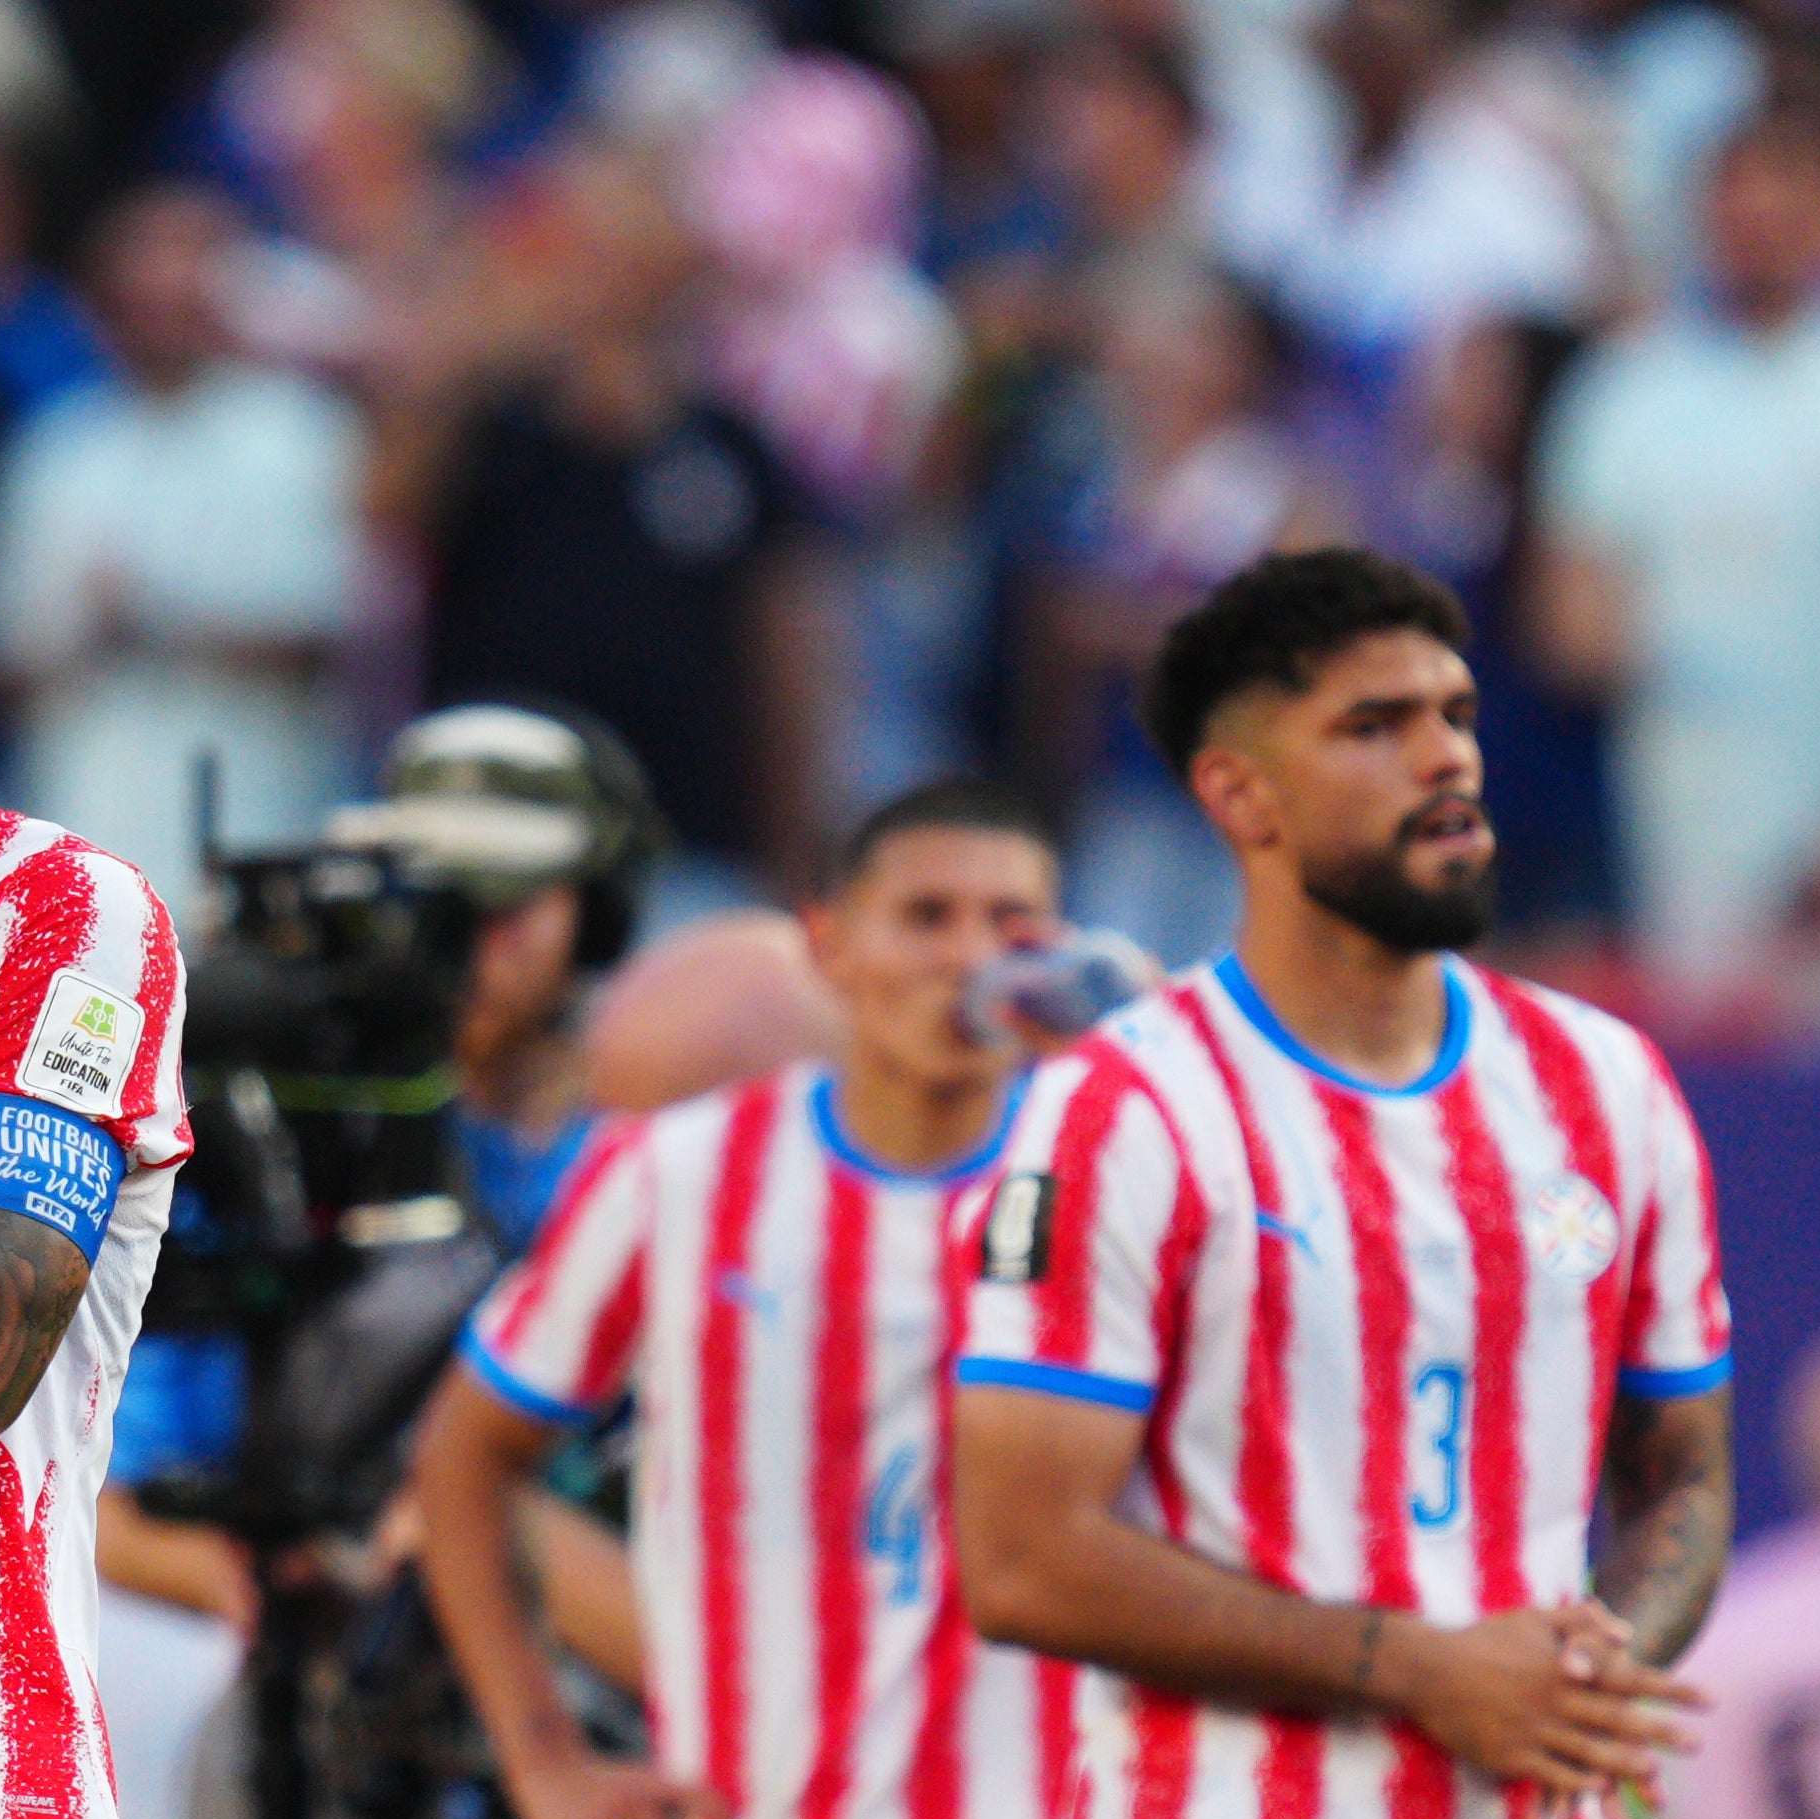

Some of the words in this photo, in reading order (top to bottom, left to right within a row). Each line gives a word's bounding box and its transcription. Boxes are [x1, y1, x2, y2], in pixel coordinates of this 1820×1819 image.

[42, 1050, 112, 1094] EDUCATION
[59, 1030, 95, 1057] Unite
[96, 1046, 112, 1065] For
[61, 1078, 85, 1096] FIFA
[1, 1106, 112, 1171] FOOTBALL
[1, 1126, 111, 1199] UNITES
[30, 1197, 73, 1225] FIFA
[45, 1168, 107, 1232] World
[1409, 1360, 1467, 1531] 3
[868, 1442, 922, 1608] 4
